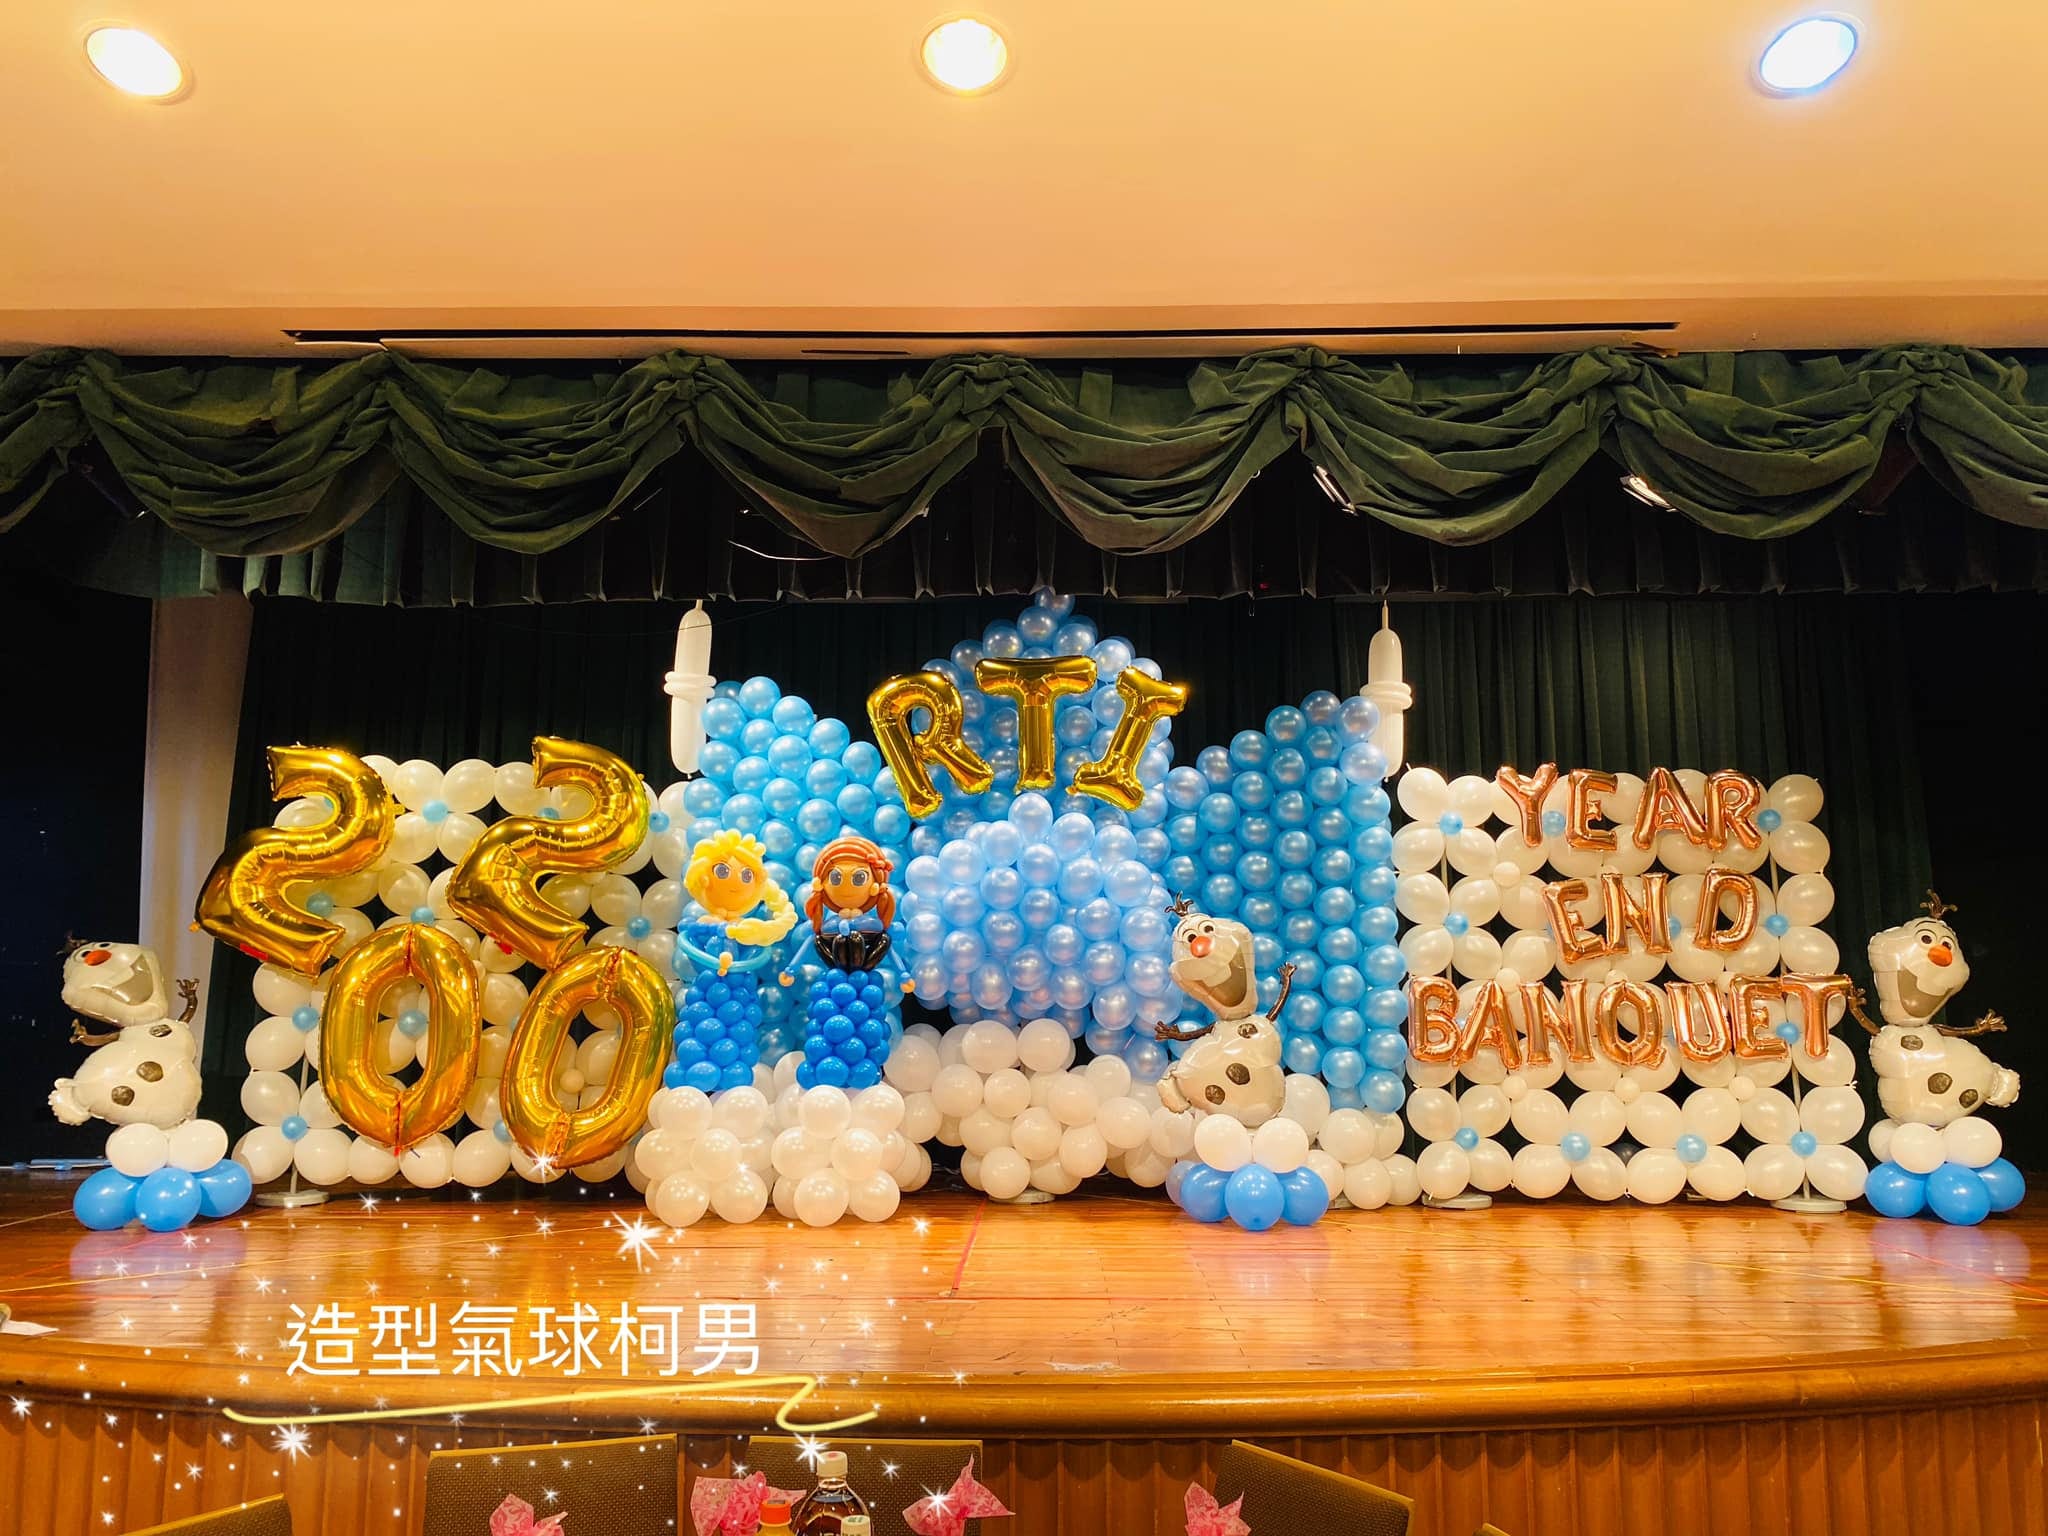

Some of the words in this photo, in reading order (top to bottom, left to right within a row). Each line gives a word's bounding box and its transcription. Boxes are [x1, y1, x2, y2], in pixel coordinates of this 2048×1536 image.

[867, 655, 1187, 818] RTI
[1496, 761, 1763, 852] YEAR
[1543, 866, 1760, 964] END
[1408, 972, 1853, 1070] BANQUET
